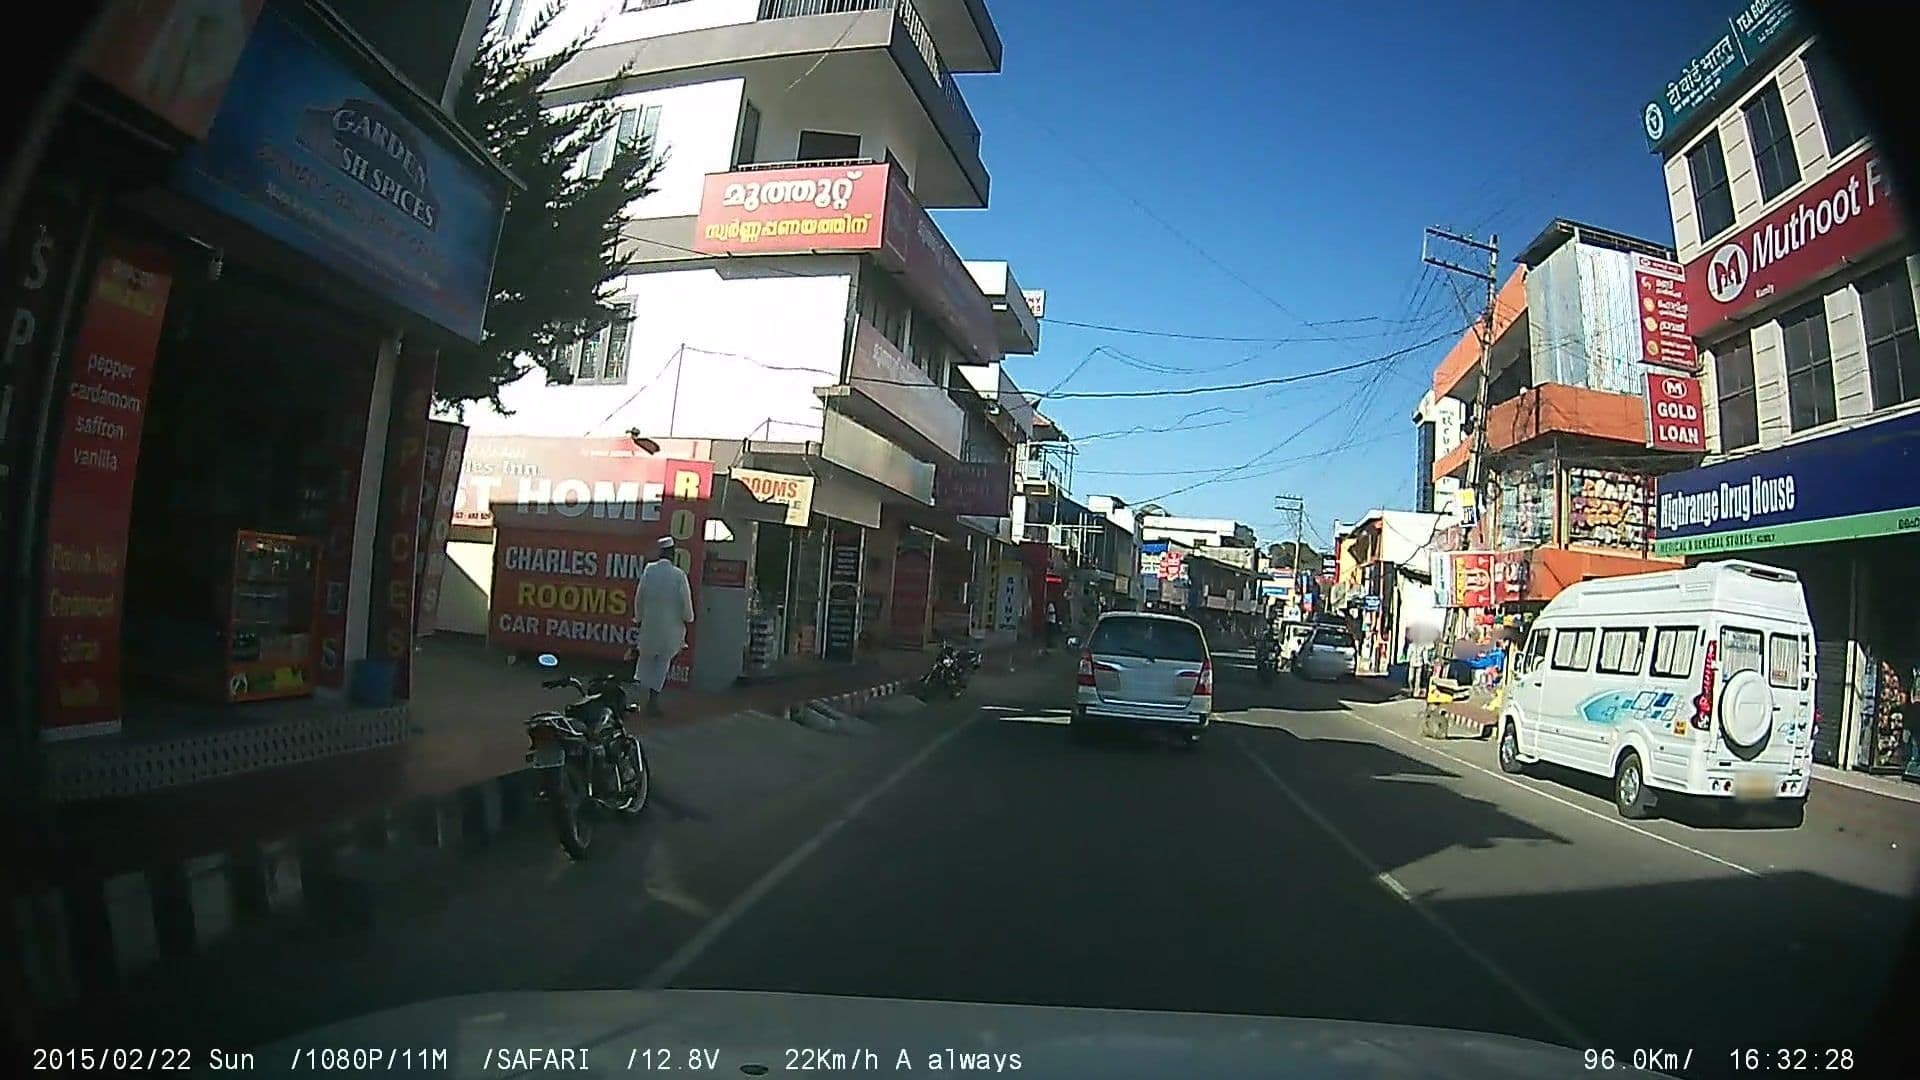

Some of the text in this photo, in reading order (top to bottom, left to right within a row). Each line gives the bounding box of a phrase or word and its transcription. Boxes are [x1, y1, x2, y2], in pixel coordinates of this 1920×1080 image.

[1736, 10, 1754, 32] TEA
[1666, 82, 1682, 106] टी
[1700, 35, 1734, 70] भारत
[332, 109, 426, 193] GARDEN
[370, 168, 434, 227] SPICES
[1751, 175, 1861, 273] Muthoot
[88, 352, 136, 381] pepper
[71, 382, 141, 413] cardamom
[1657, 402, 1697, 420] GOLD
[75, 416, 126, 441] saffron
[1659, 424, 1699, 445] LOAN
[73, 447, 120, 473] vanilla
[503, 459, 539, 478] Inn
[517, 476, 664, 522] HOME
[1660, 475, 1795, 531] Highrange Drug House
[1659, 539, 1688, 554] MEDICAL
[1694, 536, 1724, 550] GENERAL
[1726, 533, 1753, 547] STORES
[505, 546, 646, 579] CHARLES INN
[518, 581, 627, 615] ROOMS
[500, 613, 640, 646] CAR PARKING
